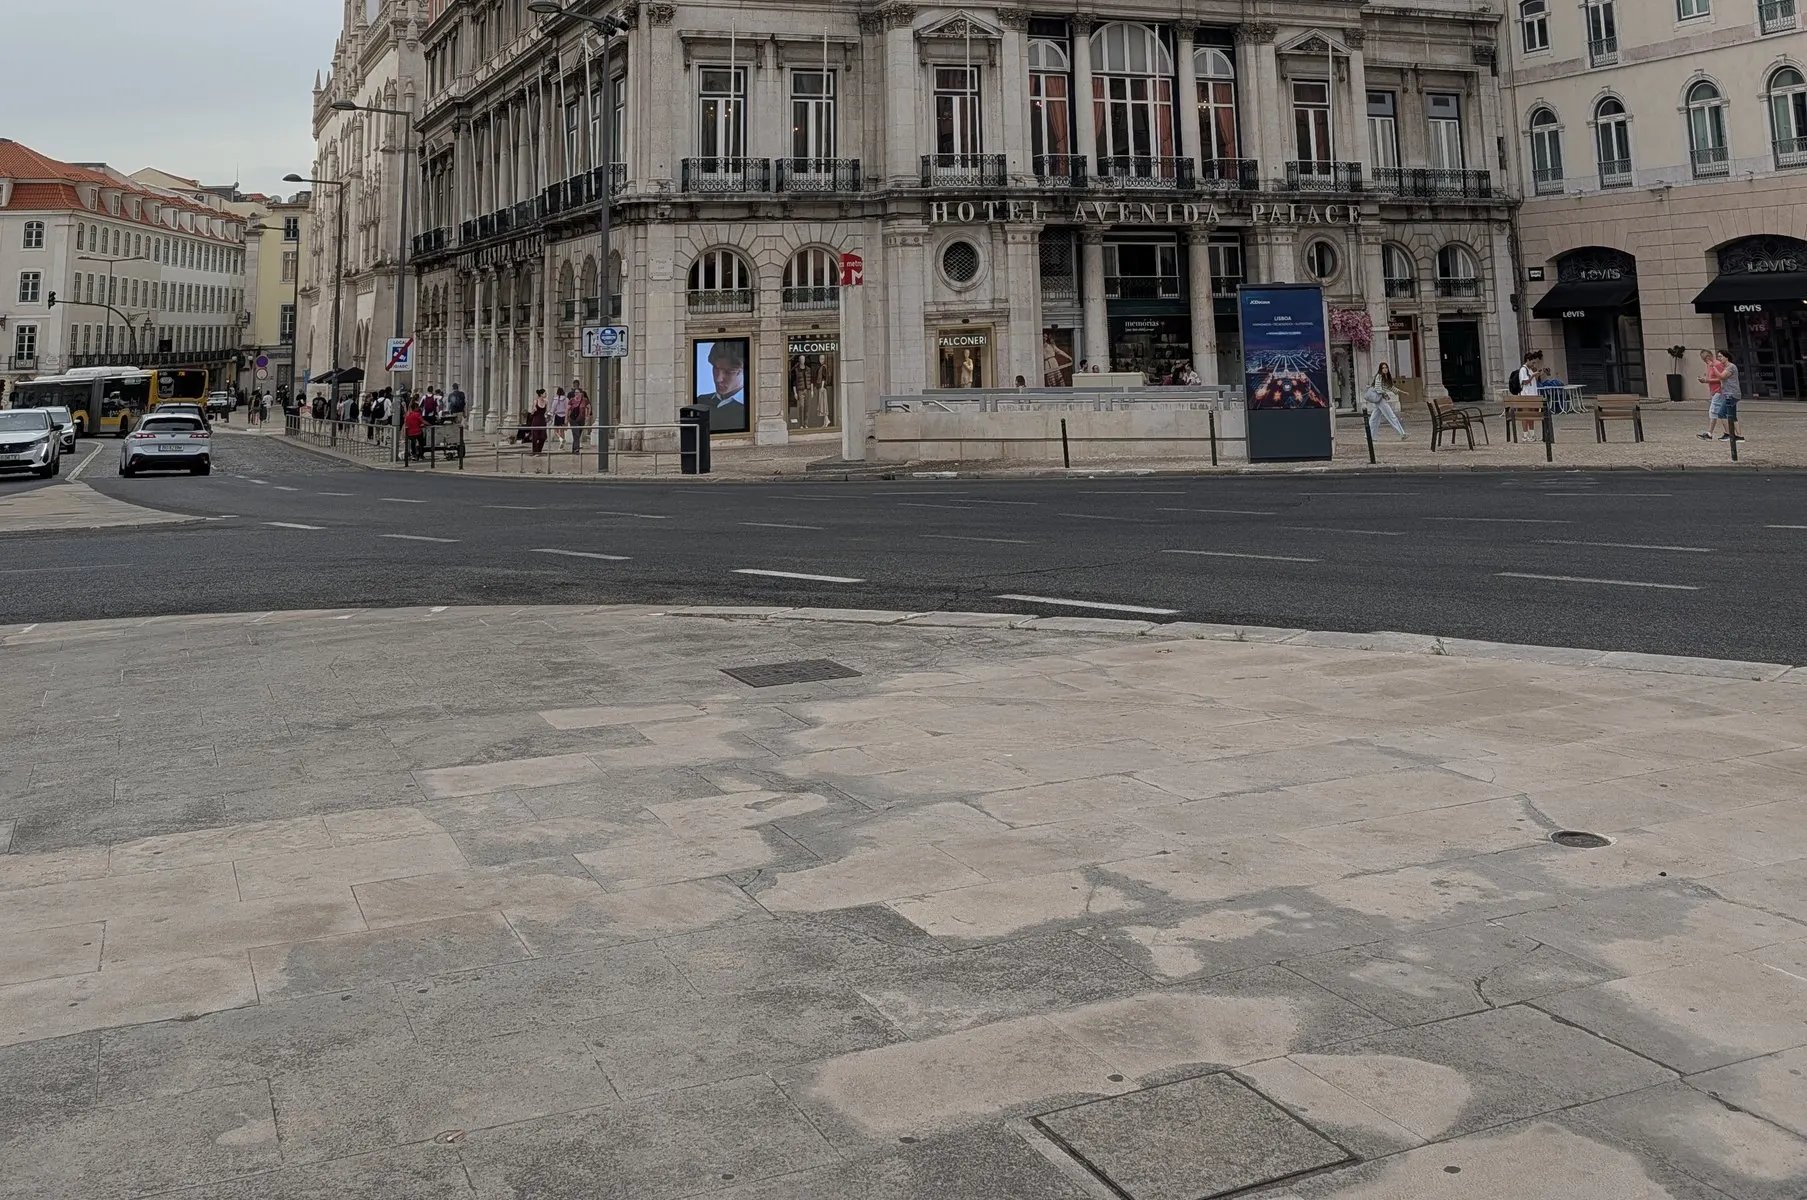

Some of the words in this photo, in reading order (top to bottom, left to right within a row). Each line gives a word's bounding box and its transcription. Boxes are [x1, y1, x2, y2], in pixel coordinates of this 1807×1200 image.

[930, 200, 1046, 224] HOTEL
[1072, 201, 1221, 224] AVENIDA
[1250, 203, 1362, 225] PALACE
[1125, 318, 1159, 327] memórias
[938, 336, 987, 346] FALCONERI
[788, 342, 839, 352] FALCONERI
